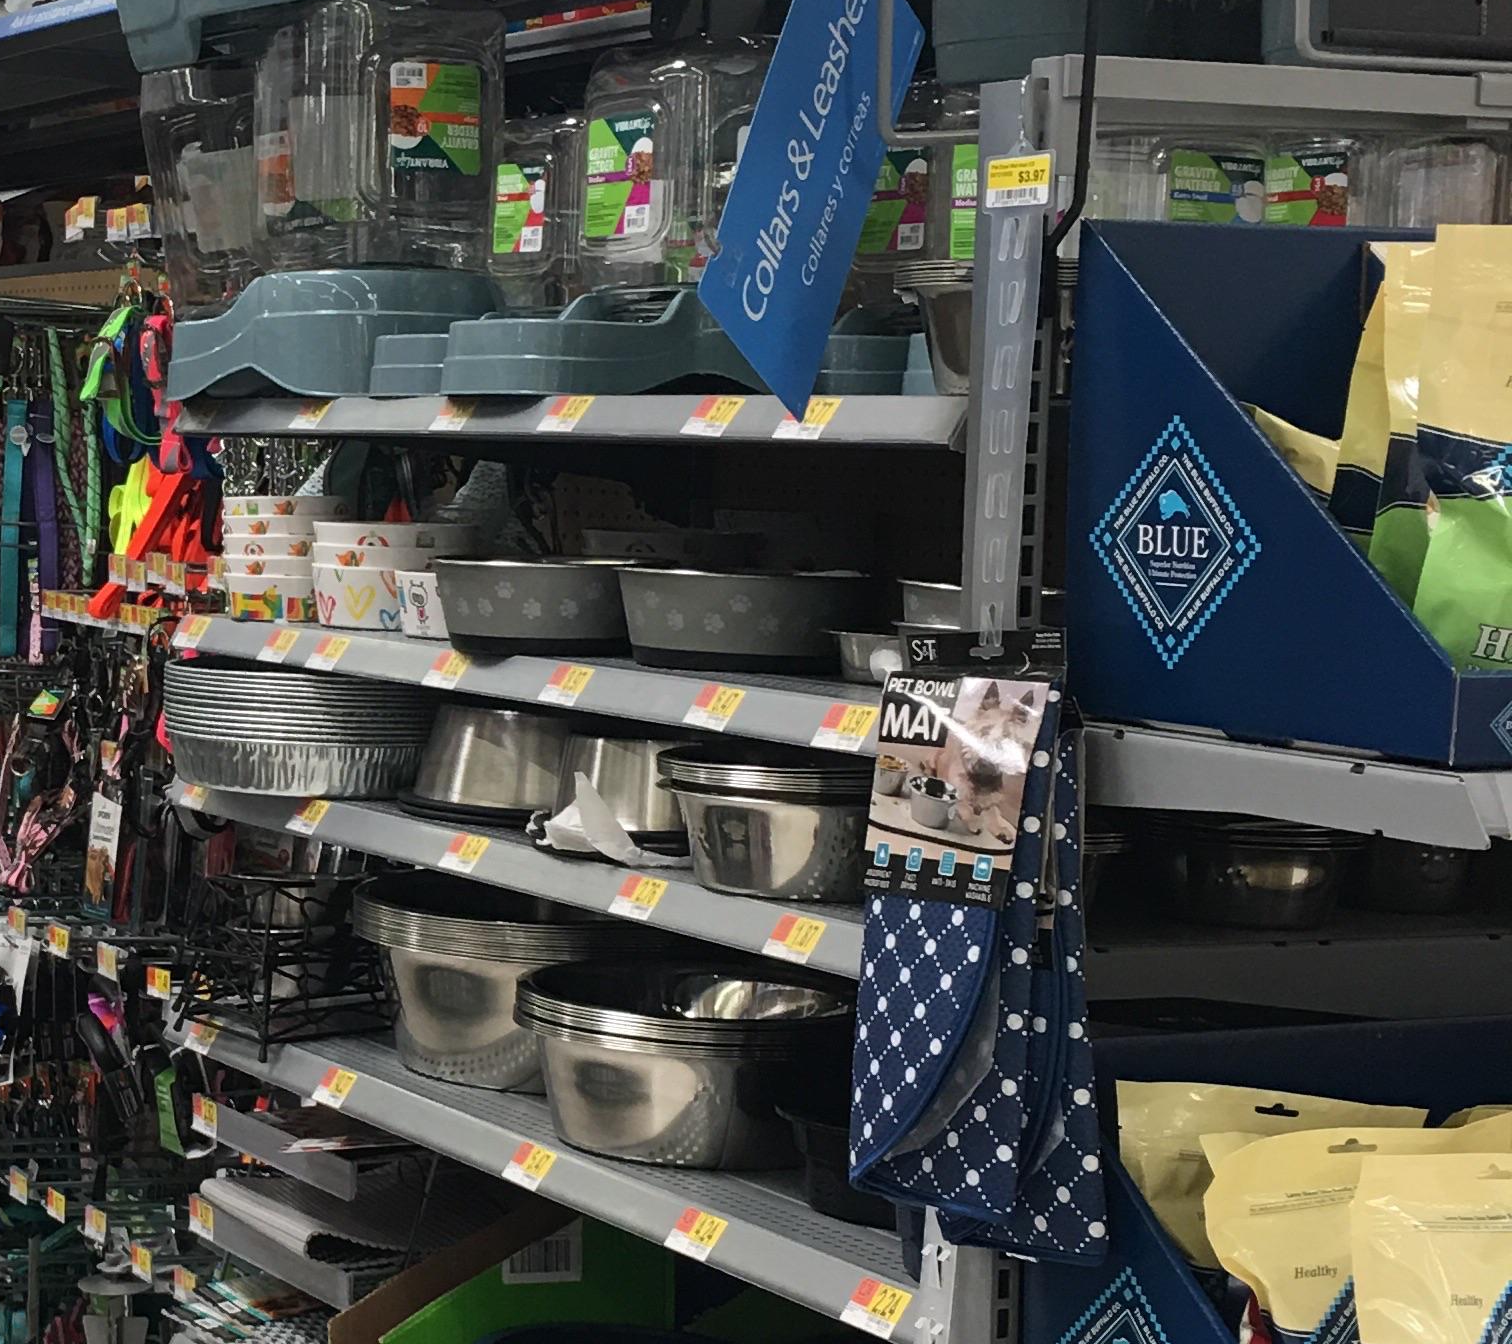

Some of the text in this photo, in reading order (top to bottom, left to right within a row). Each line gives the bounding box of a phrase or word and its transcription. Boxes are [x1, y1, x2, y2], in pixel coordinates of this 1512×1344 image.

[956, 169, 978, 181] GRA
[1018, 169, 1046, 183] $3.97
[1174, 166, 1218, 179] GRAVITY
[802, 90, 871, 287] Collares y correas
[956, 182, 978, 196] WAT
[742, 180, 799, 322] Collars
[788, 139, 815, 180] &
[1181, 453, 1193, 472] THE
[1191, 469, 1206, 491] BLUE
[1202, 488, 1227, 523] BUFFALO
[1137, 524, 1211, 558] BLUE
[1121, 562, 1136, 585] BLUE
[1186, 596, 1201, 619] BLUE
[888, 677, 957, 698] PET BOWL
[881, 702, 950, 742] MAT
[1294, 1266, 1338, 1280] Healthy
[1450, 1294, 1484, 1308] Healthy
[1134, 1308, 1146, 1330] THE
